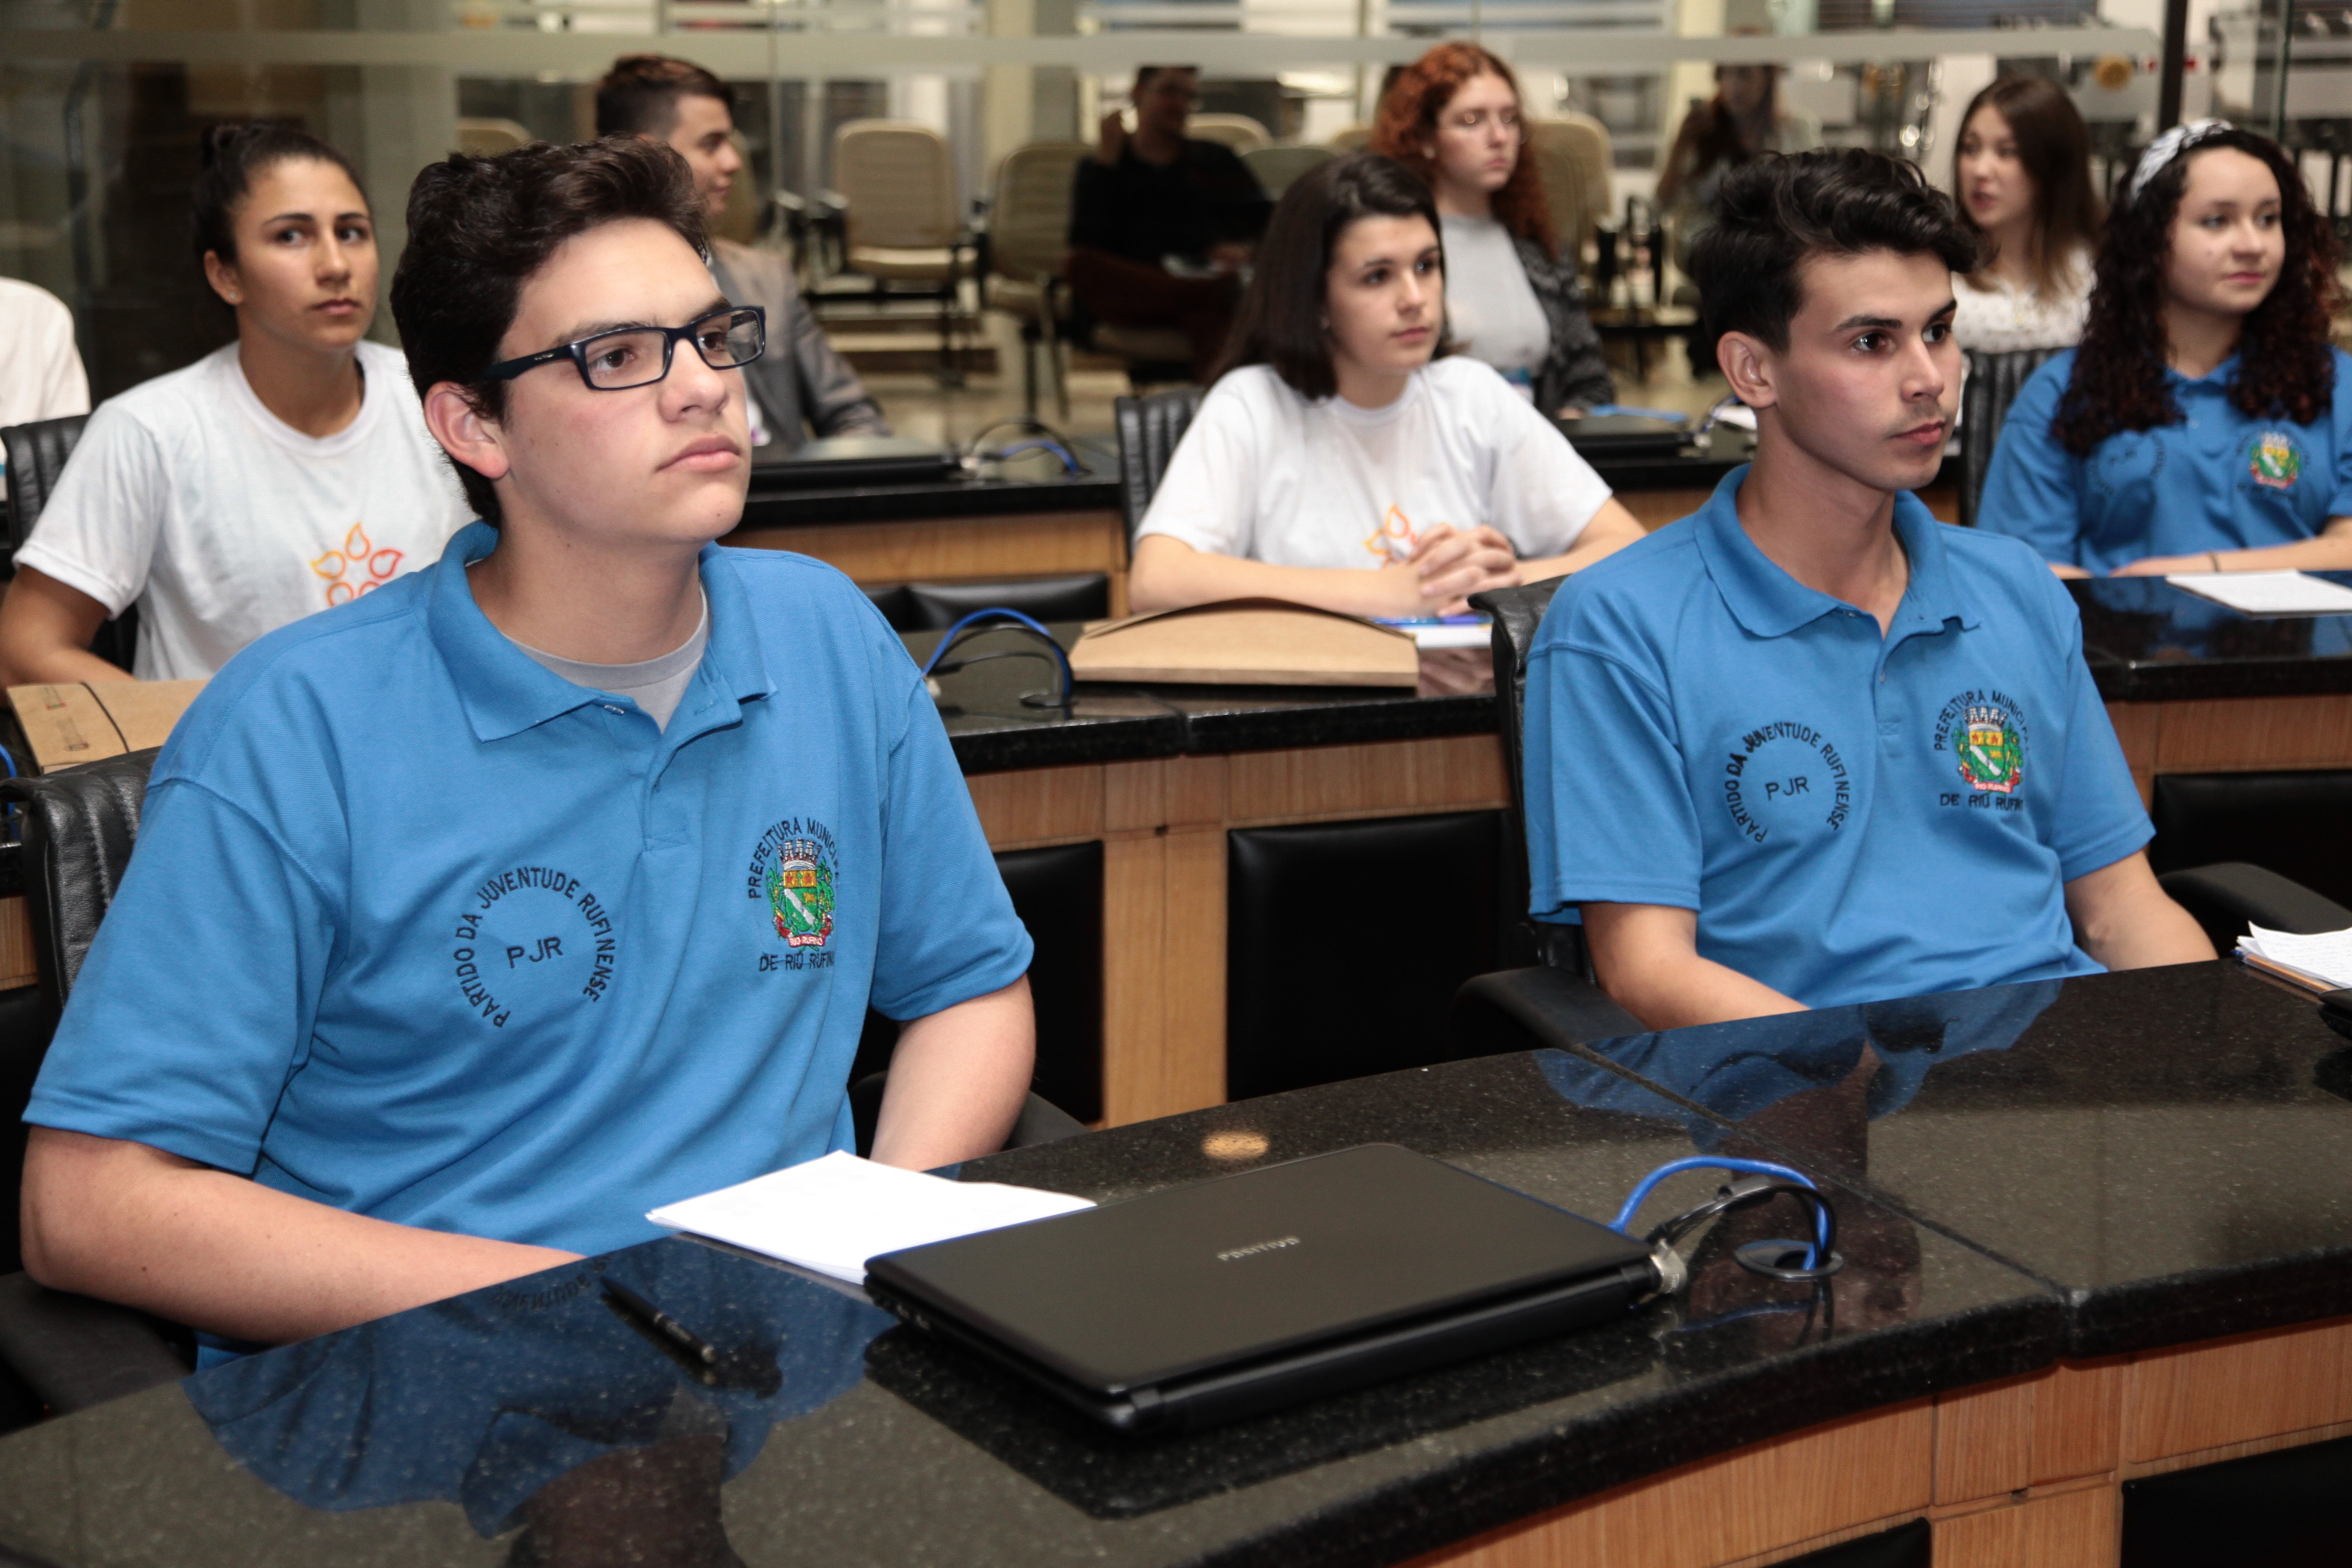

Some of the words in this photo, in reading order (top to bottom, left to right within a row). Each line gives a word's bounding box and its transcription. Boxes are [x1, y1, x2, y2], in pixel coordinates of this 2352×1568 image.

[1934, 689, 1986, 751] PREFEITURA
[1726, 753, 1748, 777] DA
[1820, 743, 1850, 830] RUFINENSE
[1765, 776, 1810, 801] PJR
[1940, 793, 1960, 807] DE
[1968, 794, 1990, 808] RIO
[1724, 779, 1767, 842] PARTIDO
[748, 817, 802, 899] PREFEITURA
[476, 866, 580, 909] JUVENTUDE
[455, 913, 483, 940] DA
[578, 893, 616, 1003] RUFINENSE
[506, 936, 564, 969] PJR
[759, 955, 779, 972] DE
[785, 952, 804, 971] RIO
[809, 950, 835, 969] RUFIN
[454, 947, 511, 1028] PARTIDO
